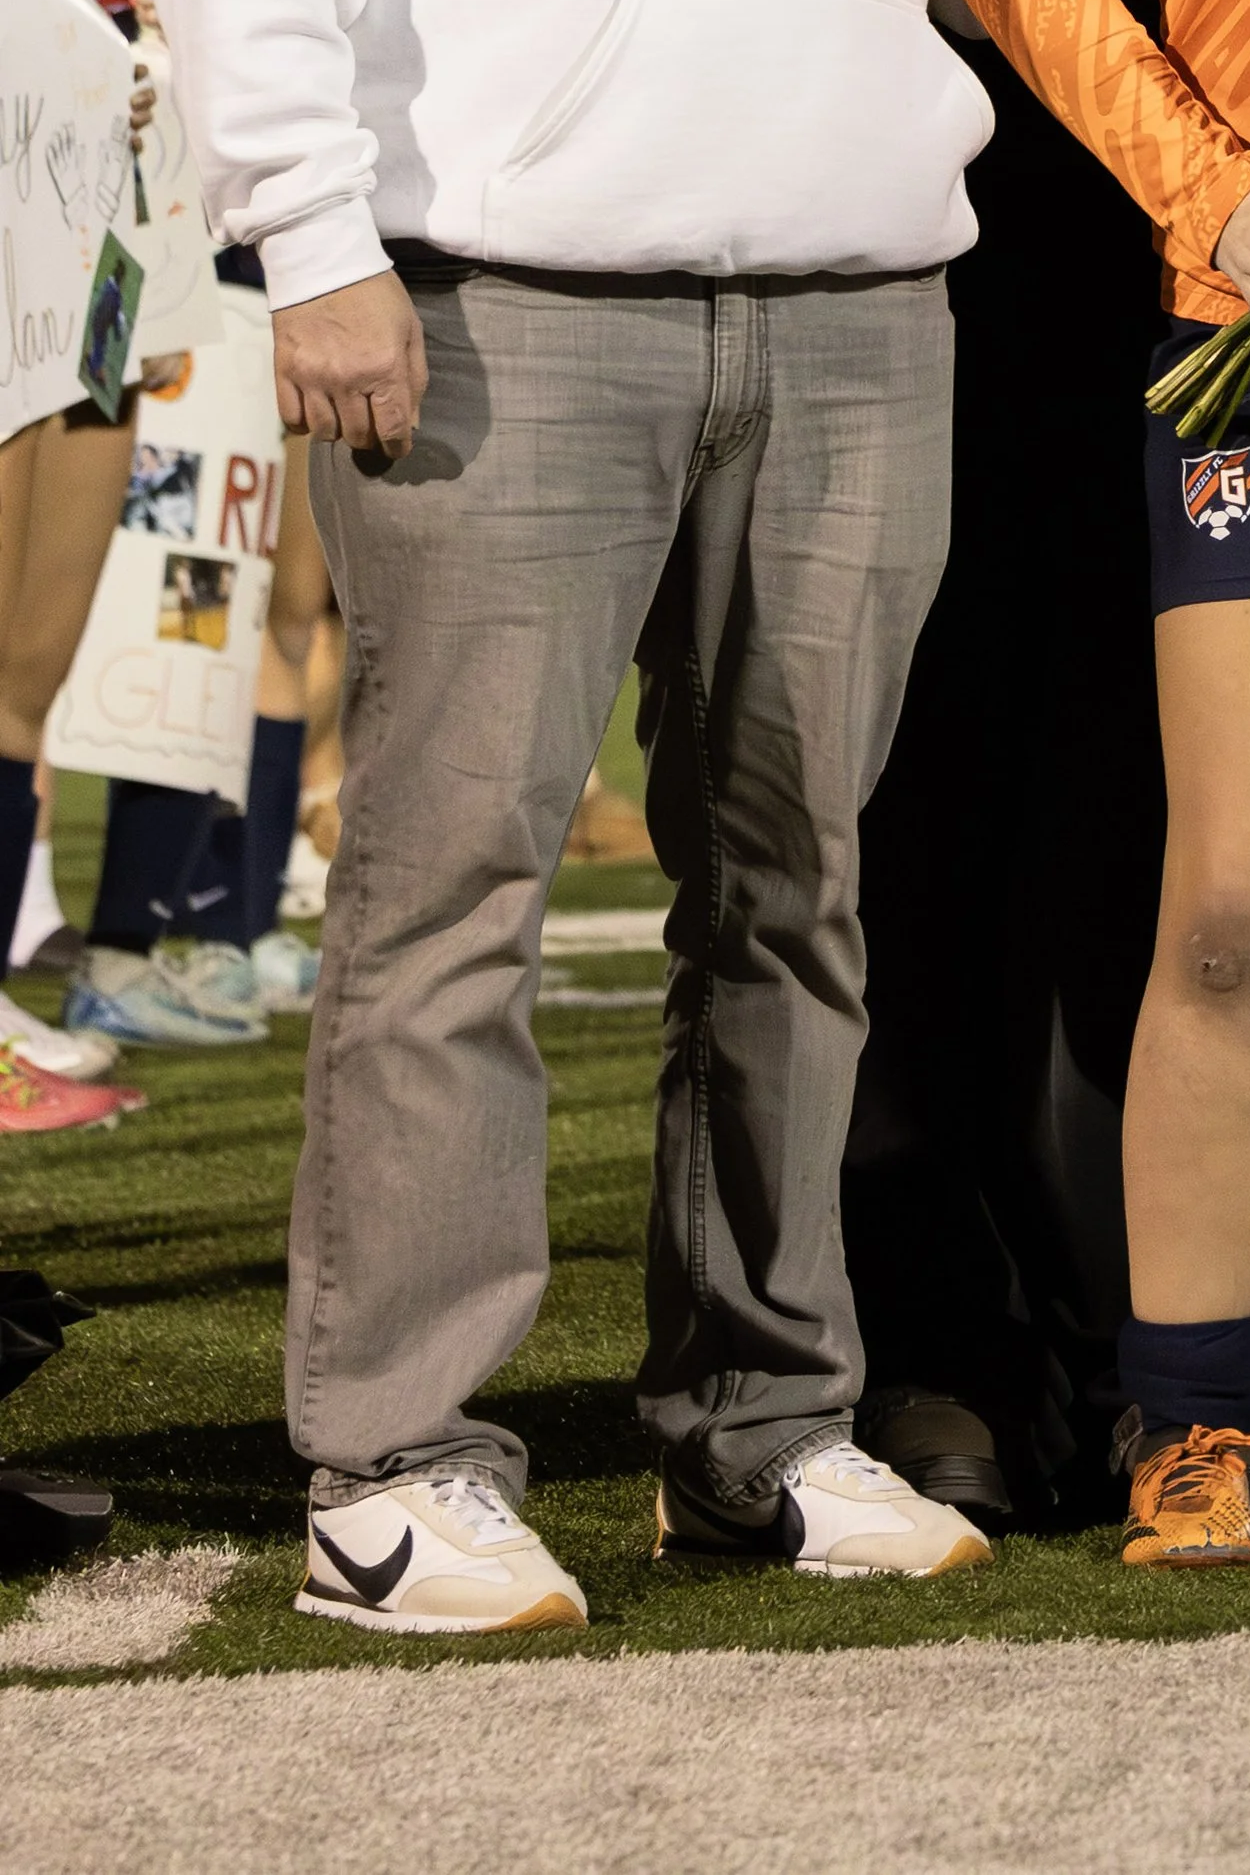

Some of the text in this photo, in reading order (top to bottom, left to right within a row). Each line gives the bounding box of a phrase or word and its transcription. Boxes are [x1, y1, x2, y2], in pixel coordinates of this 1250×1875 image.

[1186, 456, 1224, 504] GRIZZLY FC
[1220, 466, 1247, 506] G
